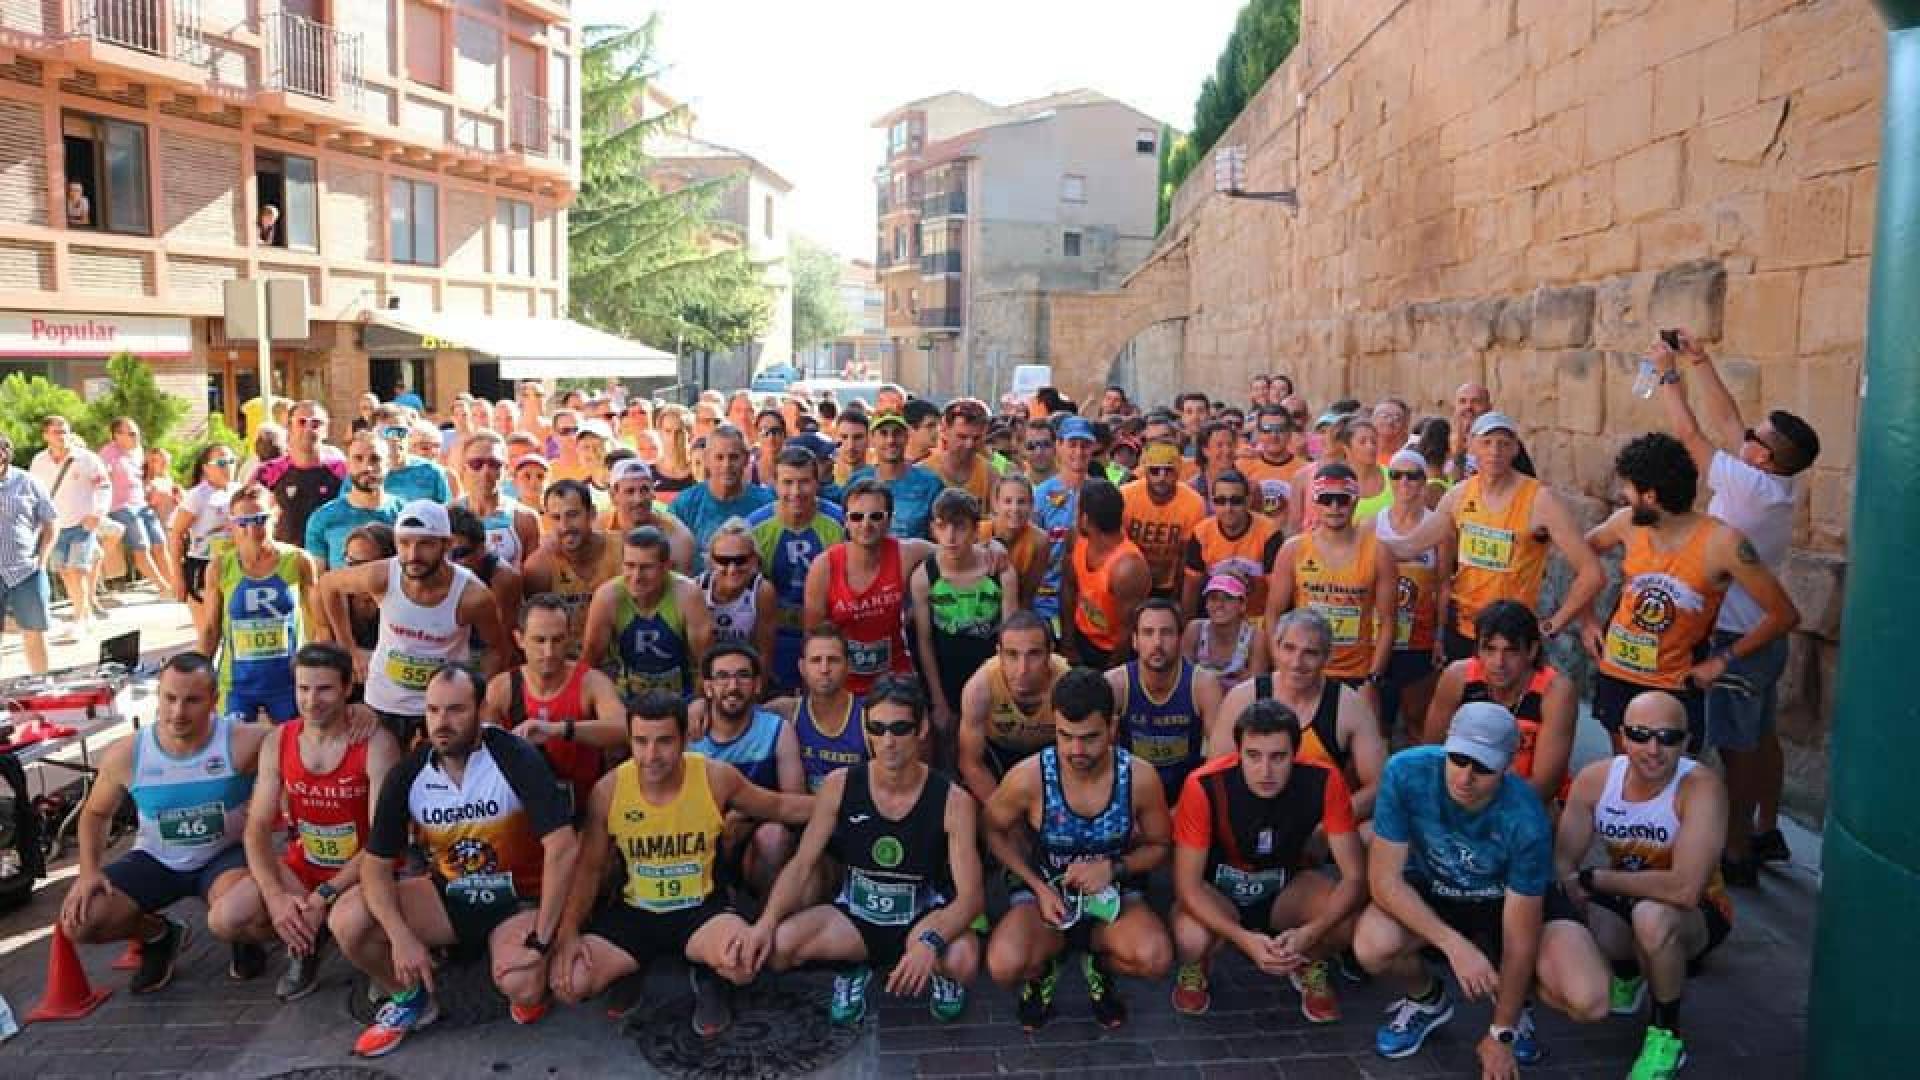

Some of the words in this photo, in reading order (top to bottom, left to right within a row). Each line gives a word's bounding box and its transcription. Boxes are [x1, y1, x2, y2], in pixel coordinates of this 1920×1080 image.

[32, 319, 115, 344] Popular
[1129, 519, 1181, 545] BEER
[787, 541, 813, 566] R
[245, 587, 288, 620] R
[635, 628, 672, 657] R
[401, 666, 427, 683] 55
[423, 799, 499, 824] LOGROÑO
[176, 820, 208, 836] 46
[315, 839, 339, 857] 38
[627, 832, 706, 859] JAMAICA
[463, 888, 496, 904] 70
[655, 880, 682, 897] 19
[1235, 882, 1264, 896] 50
[865, 893, 895, 913] 59
